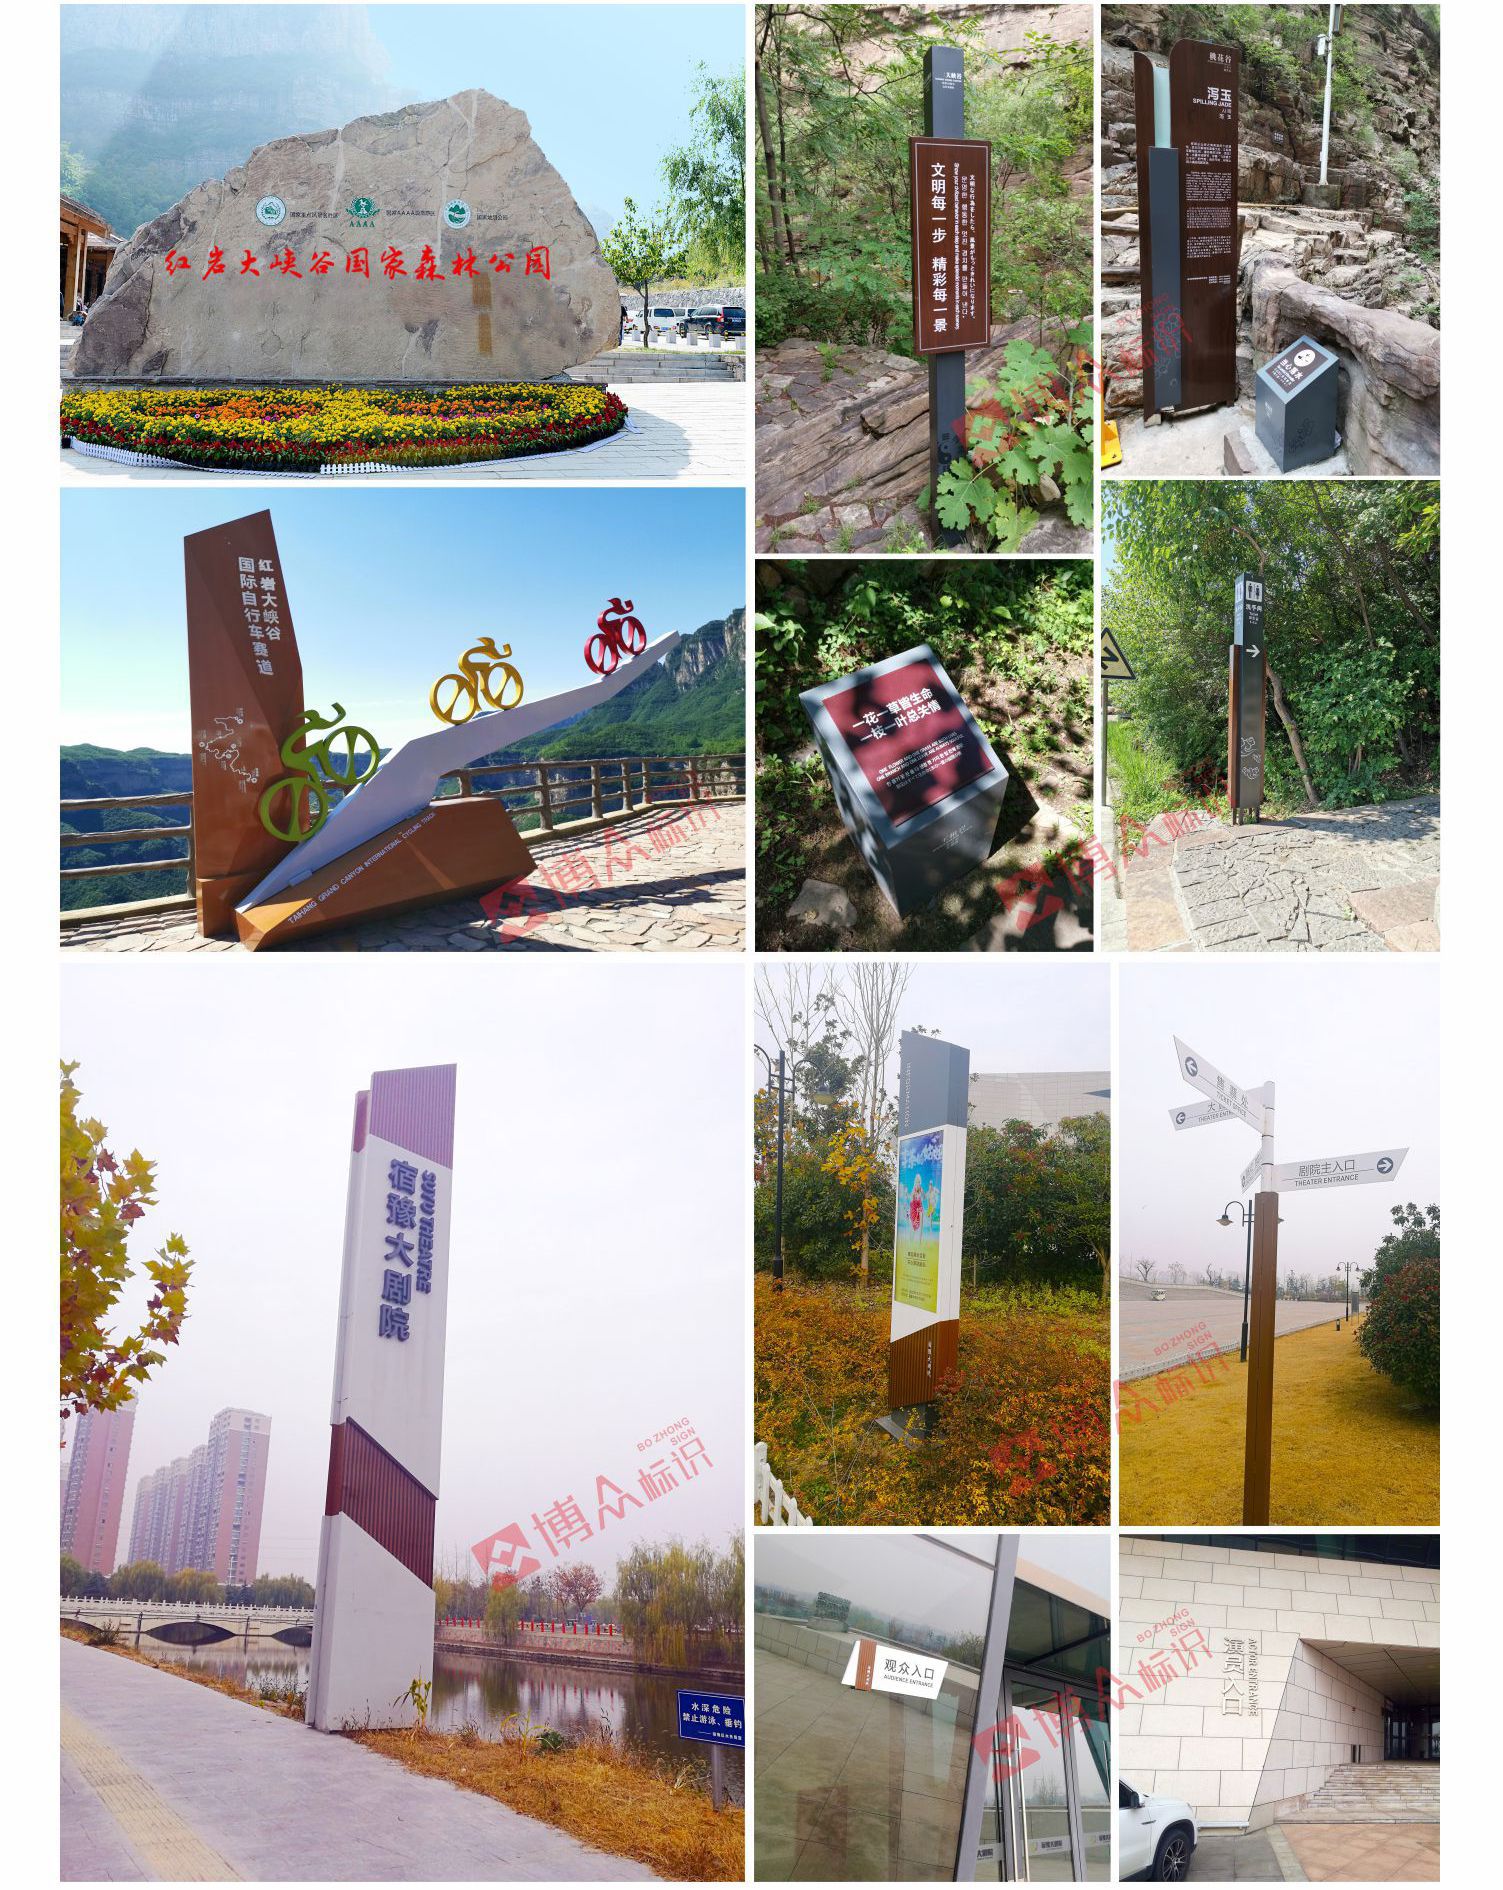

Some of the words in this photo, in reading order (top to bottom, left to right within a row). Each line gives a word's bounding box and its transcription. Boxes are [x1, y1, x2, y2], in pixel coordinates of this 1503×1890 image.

[1193, 98, 1217, 106] SPILLING
[1207, 86, 1232, 102] 泻玉
[931, 162, 947, 243] 文明每一步
[163, 244, 552, 282] 红岩大峡谷国家森林公园
[932, 256, 948, 333] 精彩每一景
[238, 556, 274, 676] 国际自行车赛道
[258, 559, 281, 641] 红岩大峡谷
[852, 687, 933, 728] 一花一草皆生命
[860, 699, 941, 742] 一枝一叶总关情
[288, 900, 318, 924] TAIHANG
[318, 884, 340, 902] GRAND
[340, 865, 364, 885] CANYON
[364, 837, 402, 868] INTERNATIONAL
[401, 823, 422, 839] CYCLING
[1295, 1176, 1323, 1187] THEATER
[1323, 1174, 1359, 1184] ENTRANCE
[1298, 1159, 1355, 1177] 剧院主入口
[420, 1170, 437, 1216] SUYU
[379, 1158, 419, 1342] 宿豫大剧院
[416, 1216, 435, 1295] THEATRE
[883, 1674, 909, 1684] AUDIENCE
[909, 1678, 934, 1688] ENTRANCE
[884, 1659, 935, 1680] 观众入口
[1222, 1637, 1245, 1716] 演员入口
[1248, 1667, 1258, 1717] ENTRANCE
